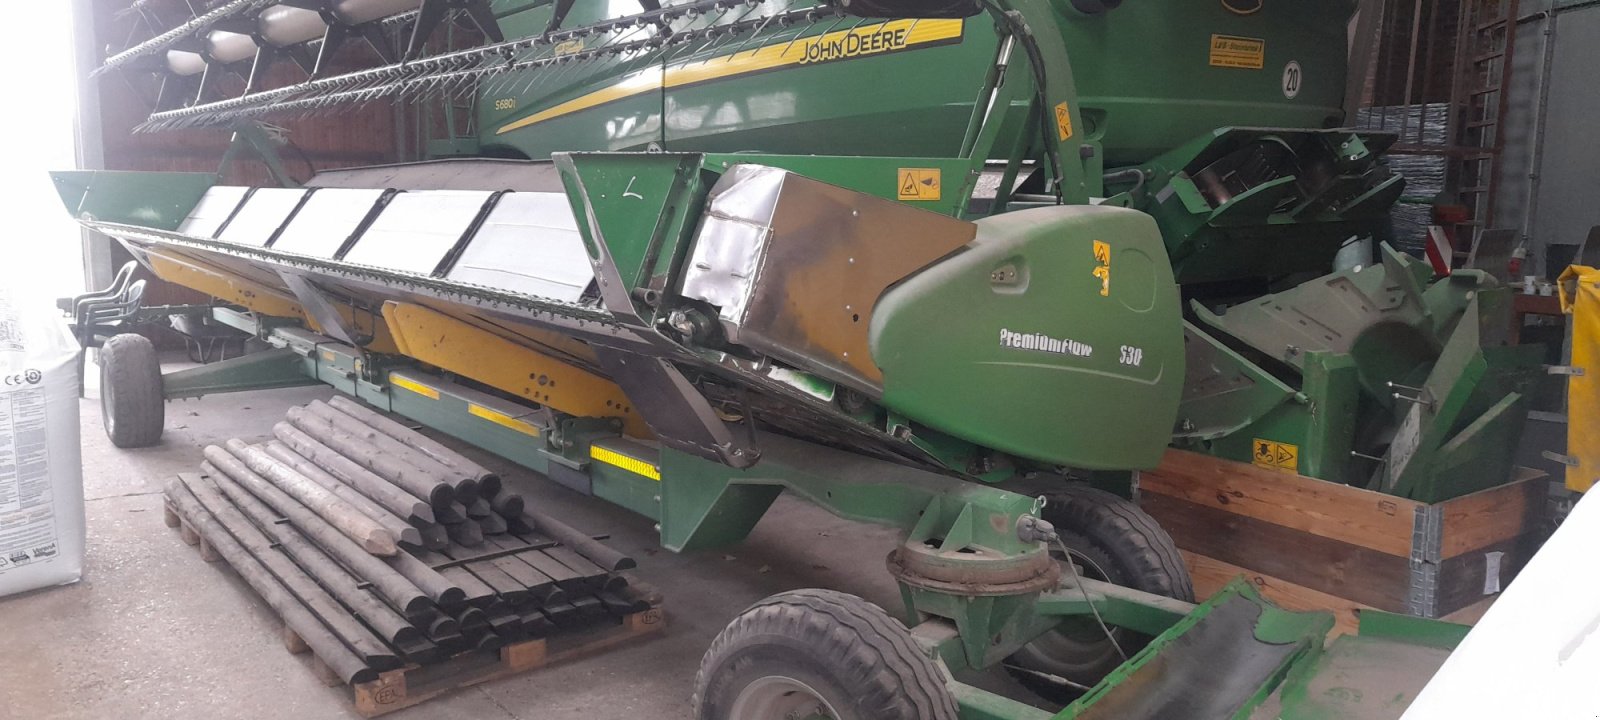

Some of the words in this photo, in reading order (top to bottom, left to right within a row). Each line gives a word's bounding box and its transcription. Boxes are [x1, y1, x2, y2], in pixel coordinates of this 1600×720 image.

[799, 39, 843, 61] JOHN
[847, 28, 905, 53] DEERE
[1286, 68, 1298, 91] 20
